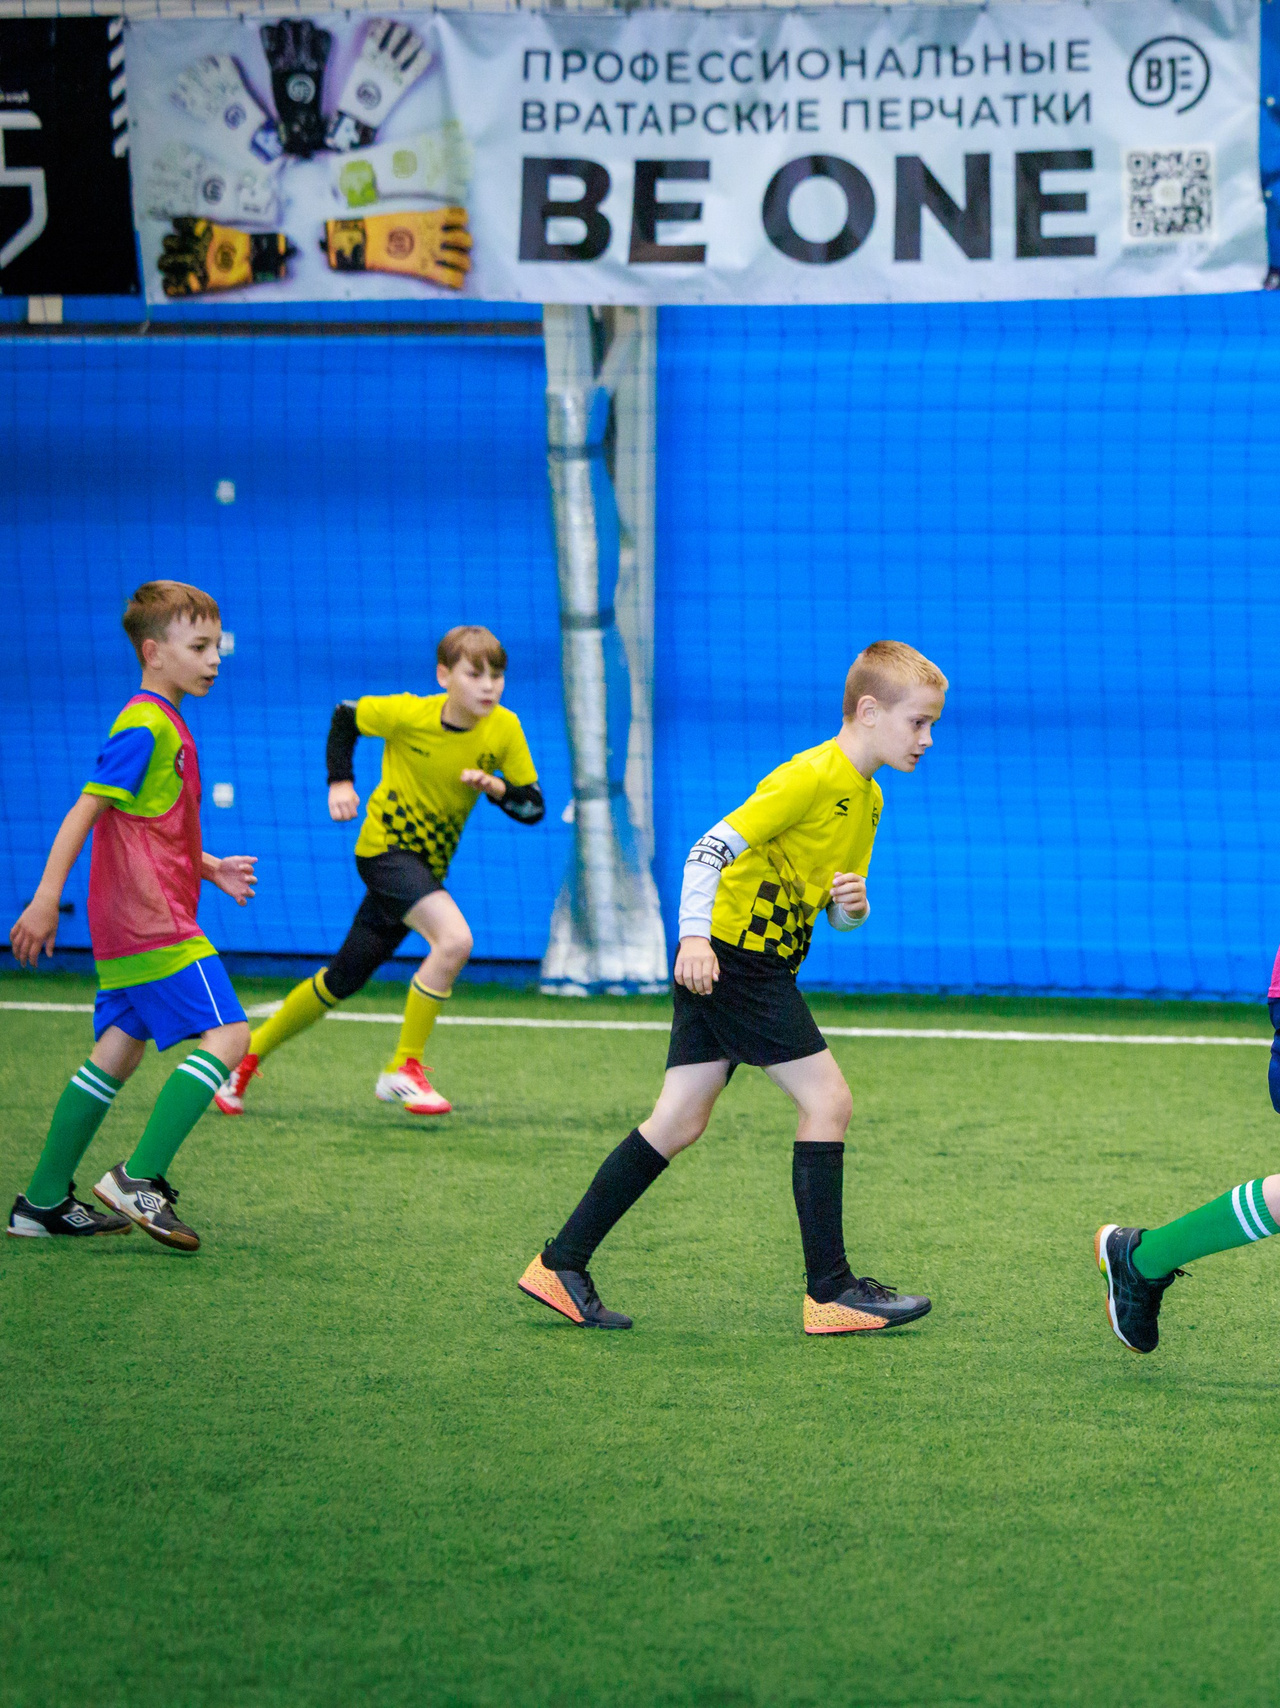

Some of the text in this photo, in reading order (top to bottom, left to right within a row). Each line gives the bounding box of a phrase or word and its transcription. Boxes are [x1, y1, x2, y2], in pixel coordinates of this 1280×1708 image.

[522, 40, 1092, 84] ПРОФЕССИОНАЛЬНЫЕ
[521, 93, 1093, 136] ВРАТАРСКИЕ ПЕРЧАТКИ
[518, 149, 1096, 265] BE ONE
